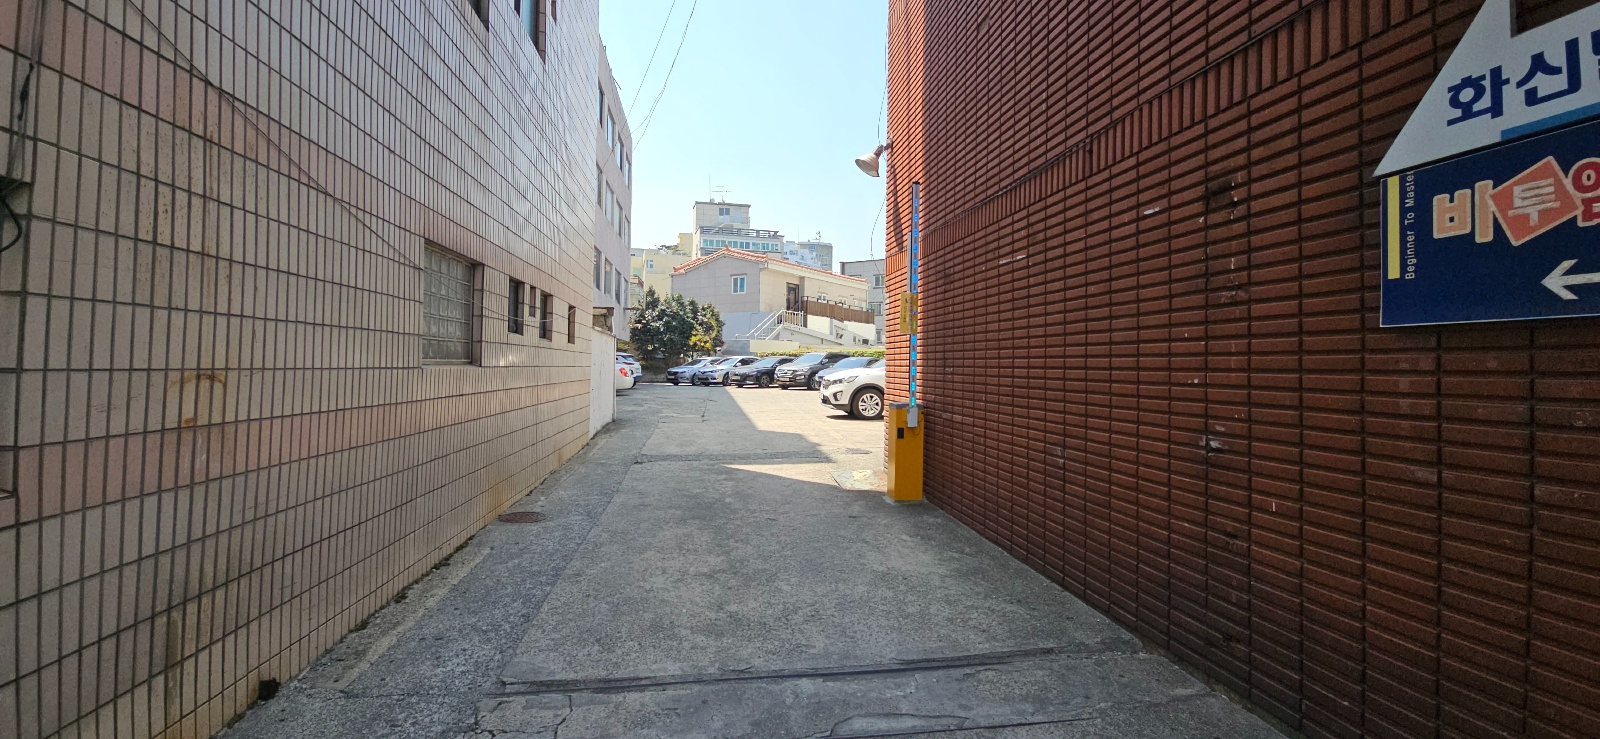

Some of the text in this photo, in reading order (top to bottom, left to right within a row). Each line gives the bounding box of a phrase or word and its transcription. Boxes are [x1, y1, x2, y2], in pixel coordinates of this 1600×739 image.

[1446, 29, 1600, 127] 화신
[1404, 212, 1415, 225] To
[1404, 230, 1416, 280] Beginner
